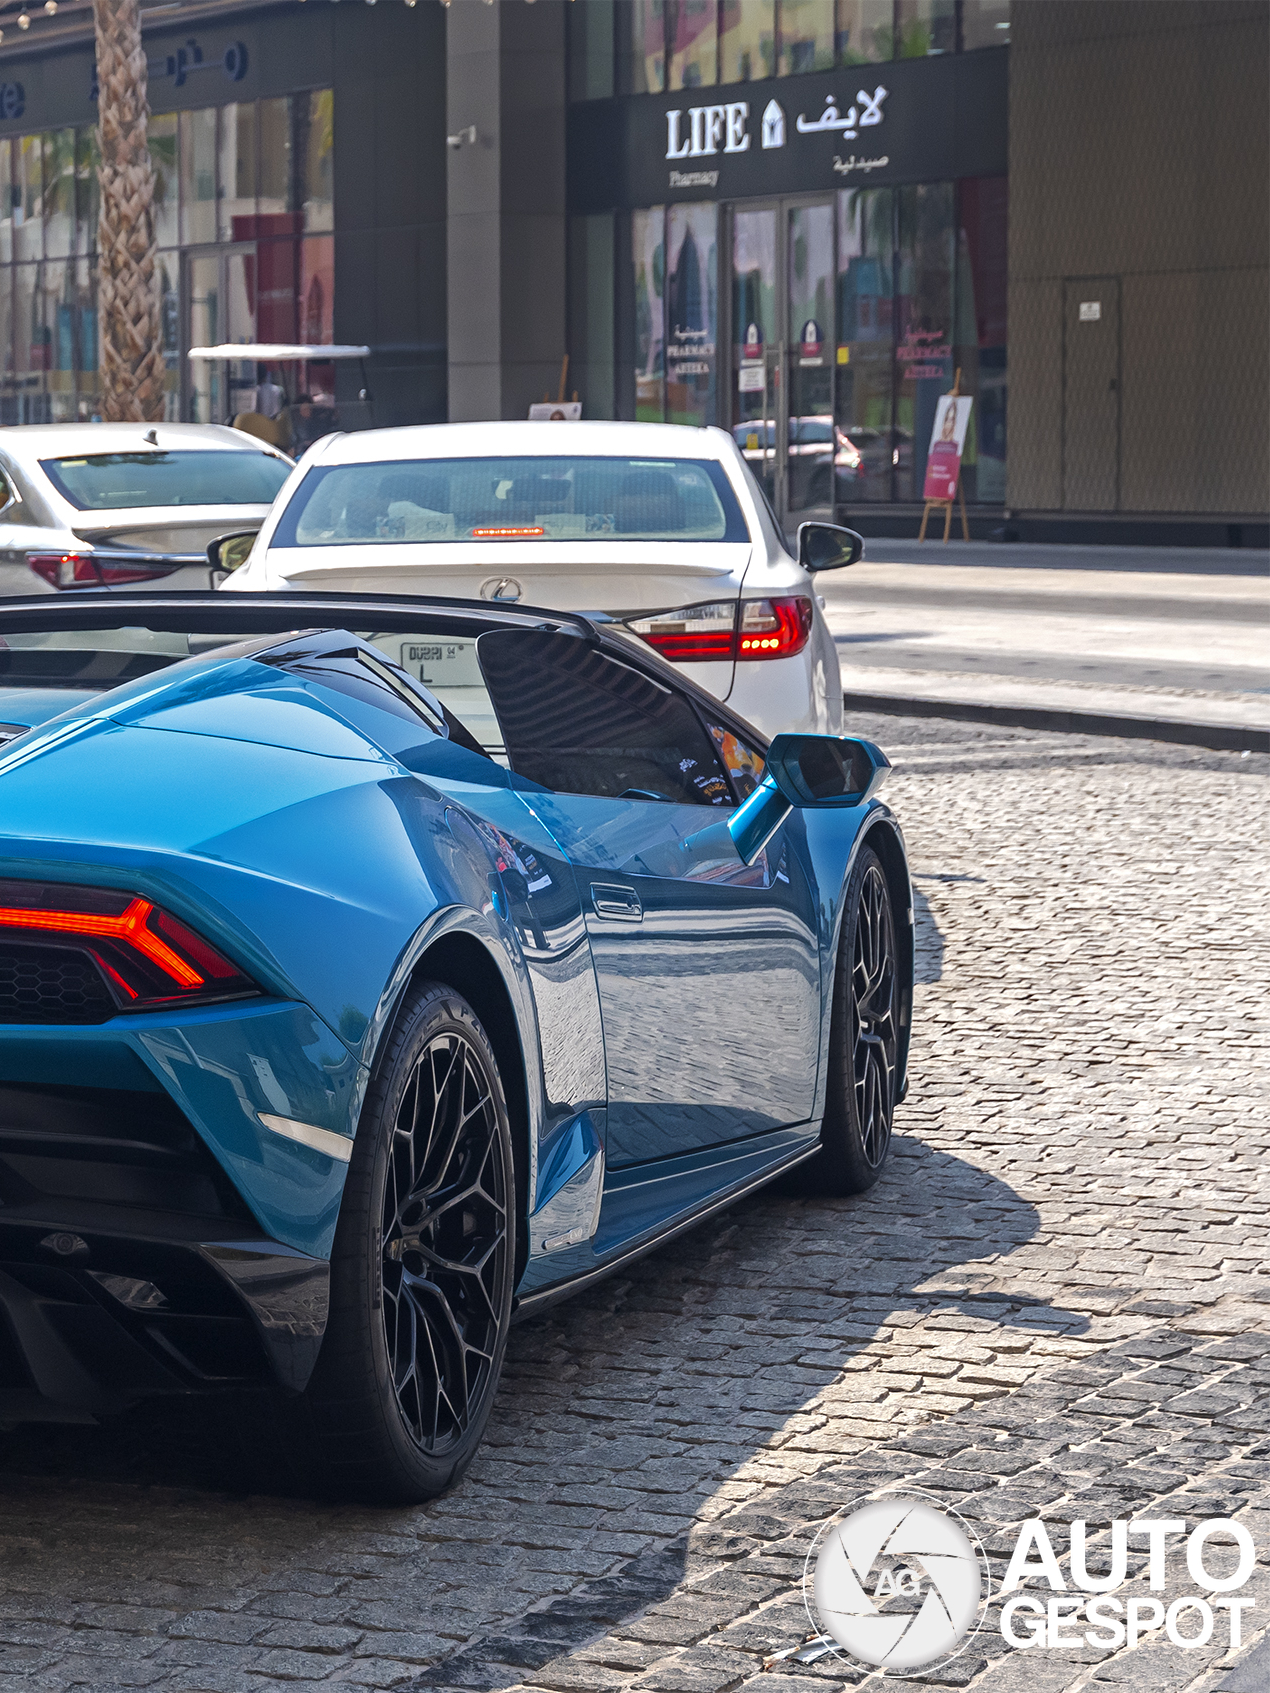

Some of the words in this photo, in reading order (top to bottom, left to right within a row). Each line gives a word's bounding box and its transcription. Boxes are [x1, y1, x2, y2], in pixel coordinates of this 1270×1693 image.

[796, 85, 888, 140] لايف
[665, 101, 750, 160] LIFE
[833, 155, 889, 175] صيدلية
[669, 170, 720, 188] Pharmacy
[420, 664, 433, 683] L
